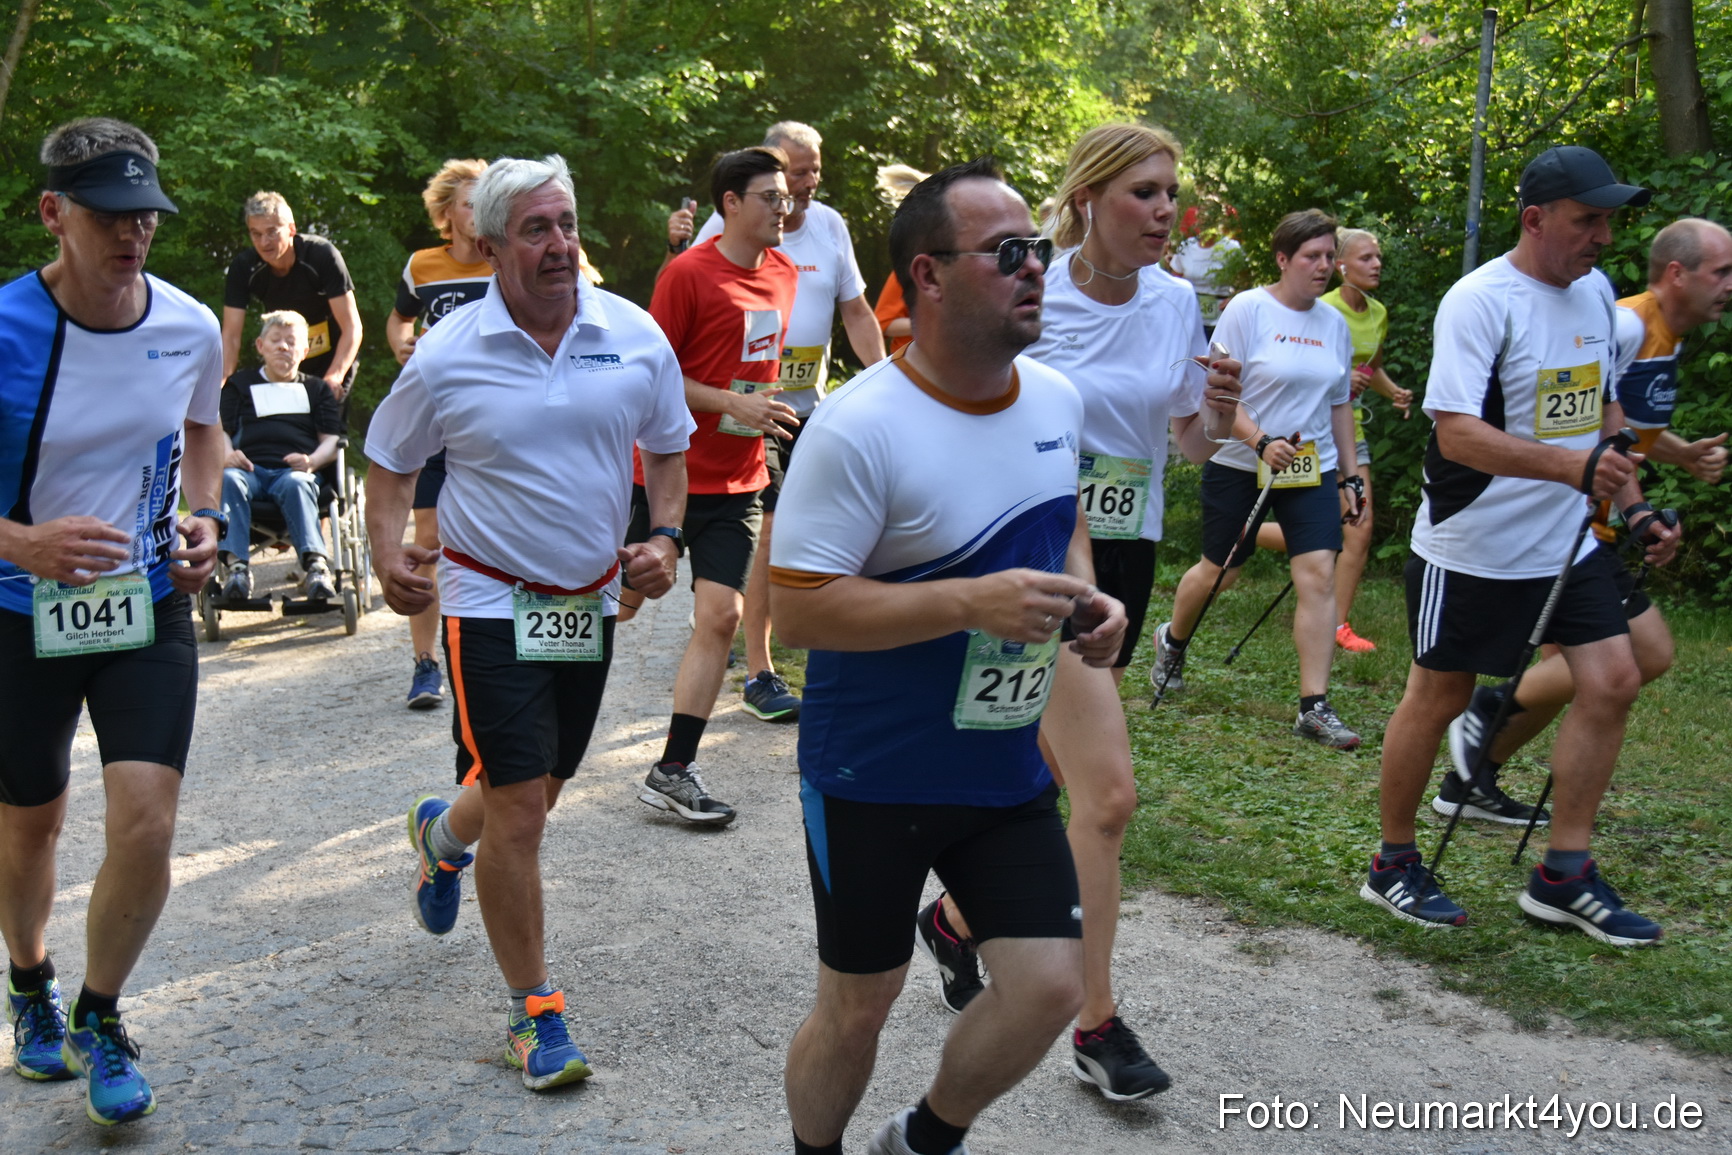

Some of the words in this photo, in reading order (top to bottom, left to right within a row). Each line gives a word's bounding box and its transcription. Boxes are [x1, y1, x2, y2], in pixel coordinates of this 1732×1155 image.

[569, 353, 624, 370] VETTER
[1545, 387, 1597, 418] 2377
[140, 465, 152, 500] WASTE
[1081, 483, 1135, 516] 168
[123, 587, 144, 596] 2019
[49, 597, 133, 632] 1041
[526, 611, 593, 639] 2392
[65, 631, 89, 640] Gilch
[91, 628, 125, 638] Herbert
